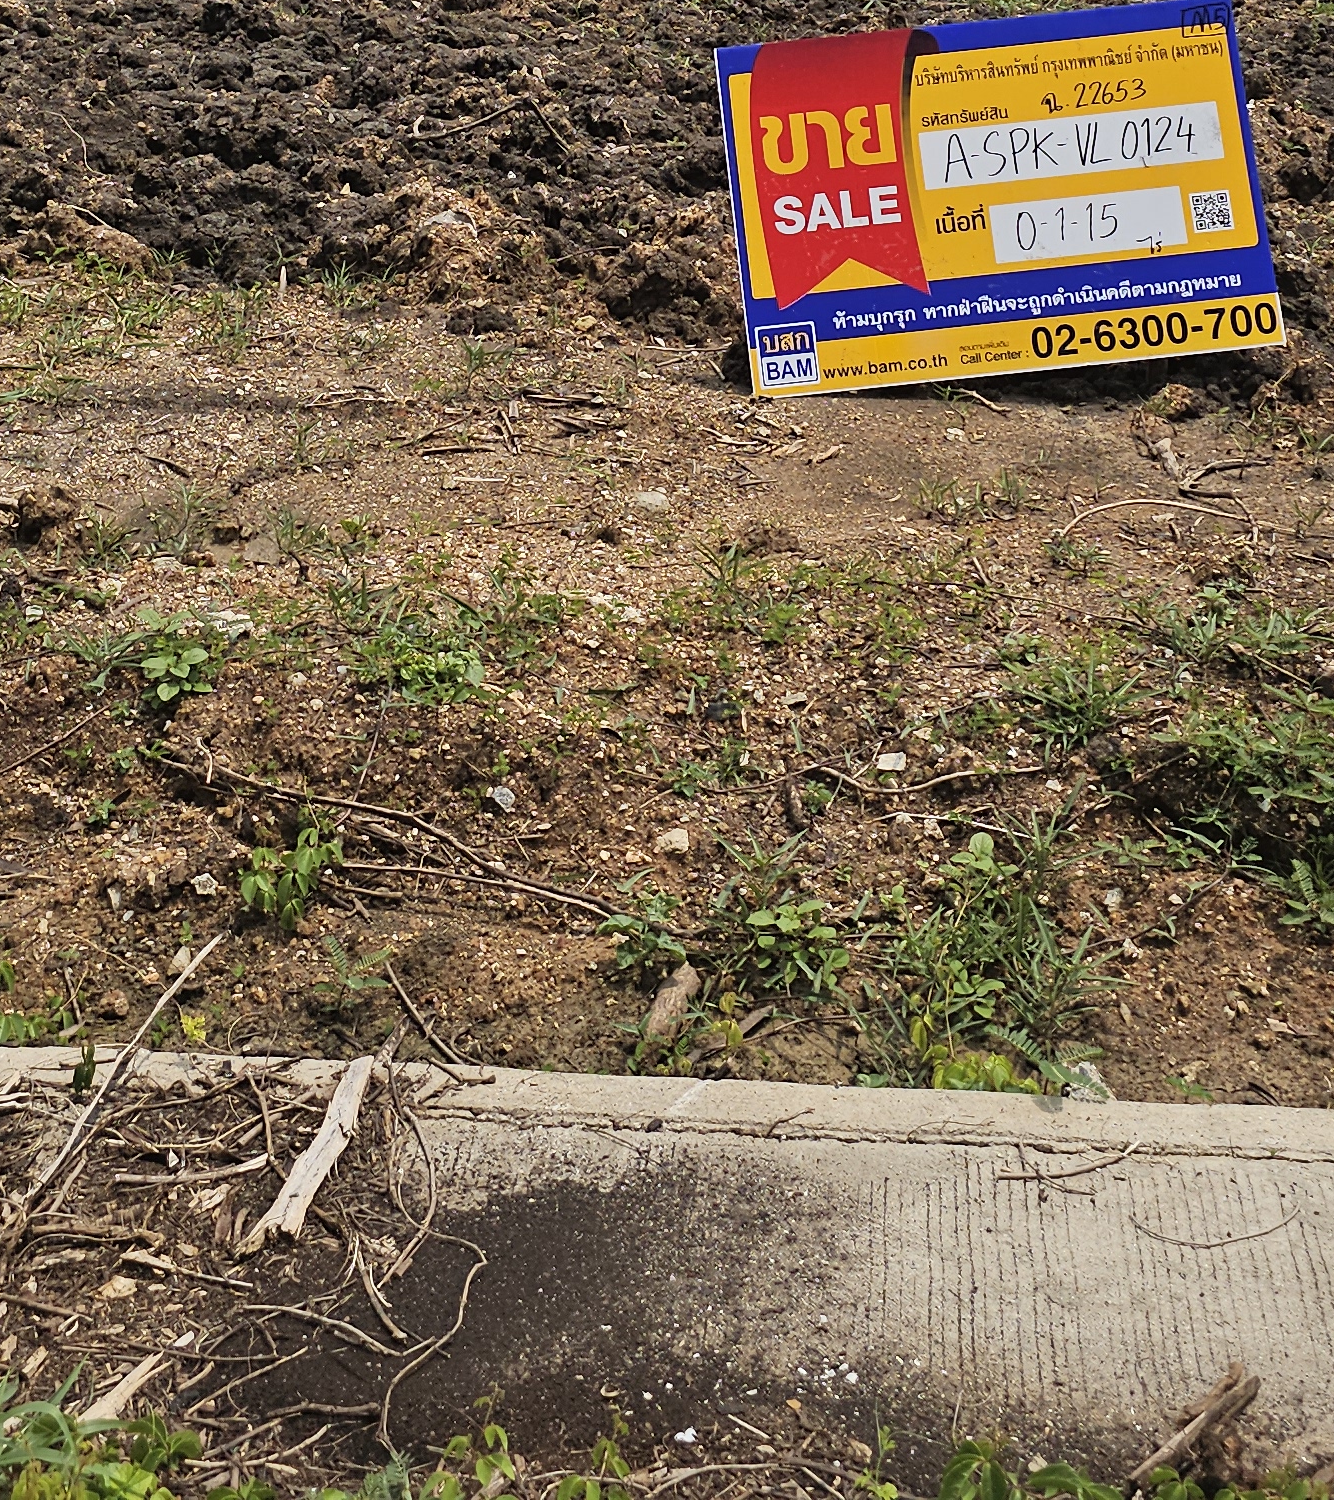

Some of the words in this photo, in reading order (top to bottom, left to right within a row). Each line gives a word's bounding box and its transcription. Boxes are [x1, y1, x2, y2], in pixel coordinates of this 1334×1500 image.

[915, 54, 1039, 87] บริษัทบริหารสินทรัพย์
[1042, 44, 1132, 79] กรุงเทพพาณิชย์
[1136, 42, 1168, 63] จำกัด
[1171, 40, 1223, 63] (มหาชน)
[1074, 78, 1147, 109] 22653
[921, 106, 1009, 128] รหัสทรัพย์สิน
[759, 103, 898, 175] ขาย
[773, 185, 902, 235] SALE
[934, 203, 987, 235] เนื้อที่
[1016, 202, 1118, 251] 0-1-15
[832, 308, 917, 332] ห้ามบุกรุก
[1031, 303, 1278, 359] 02-6300-700
[762, 331, 811, 354] บสก
[960, 352, 982, 365] Call
[984, 348, 1023, 363] Center
[765, 357, 814, 382] BAM
[822, 353, 948, 380] www.bam.co.th
